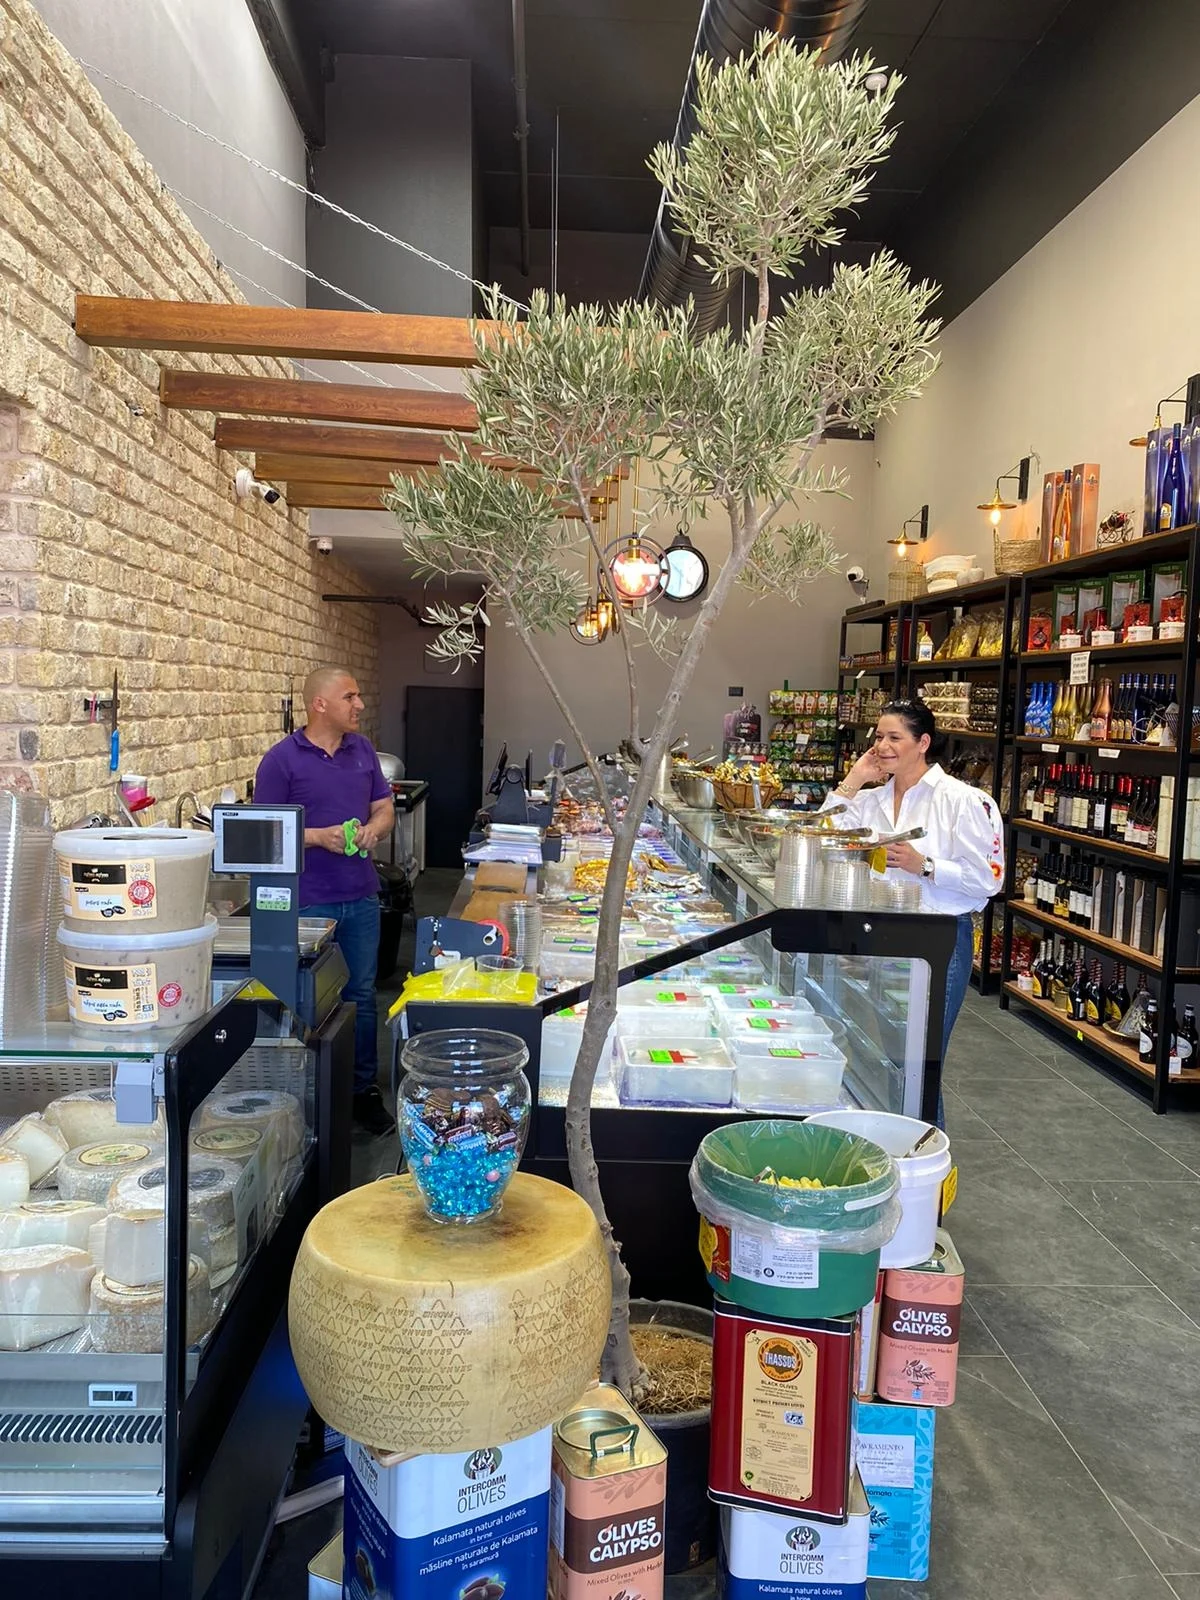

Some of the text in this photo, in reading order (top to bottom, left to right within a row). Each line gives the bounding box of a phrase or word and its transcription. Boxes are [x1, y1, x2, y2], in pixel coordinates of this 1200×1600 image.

[899, 1308, 947, 1324] OLIVES
[892, 1321, 952, 1337] CALYPSO
[765, 1352, 796, 1369] THASSOS
[779, 1383, 798, 1391] OLIVES
[458, 1474, 507, 1497] INTERCOMM
[457, 1484, 506, 1514] OLIVES
[433, 1506, 527, 1546] Kalamata natural olives
[597, 1516, 656, 1544] OLIVES
[454, 1546, 489, 1564] naturale
[489, 1541, 500, 1551] de
[501, 1526, 538, 1547] Kalamata
[476, 1531, 494, 1543] brine
[589, 1531, 662, 1563] CALYPSO
[781, 1553, 824, 1562] INTERCOMM
[780, 1561, 824, 1575] OLIVES
[586, 1575, 609, 1587] Mixed
[609, 1571, 632, 1582] Olives
[632, 1567, 646, 1576] with
[758, 1584, 842, 1596] Kalamata natural olives
